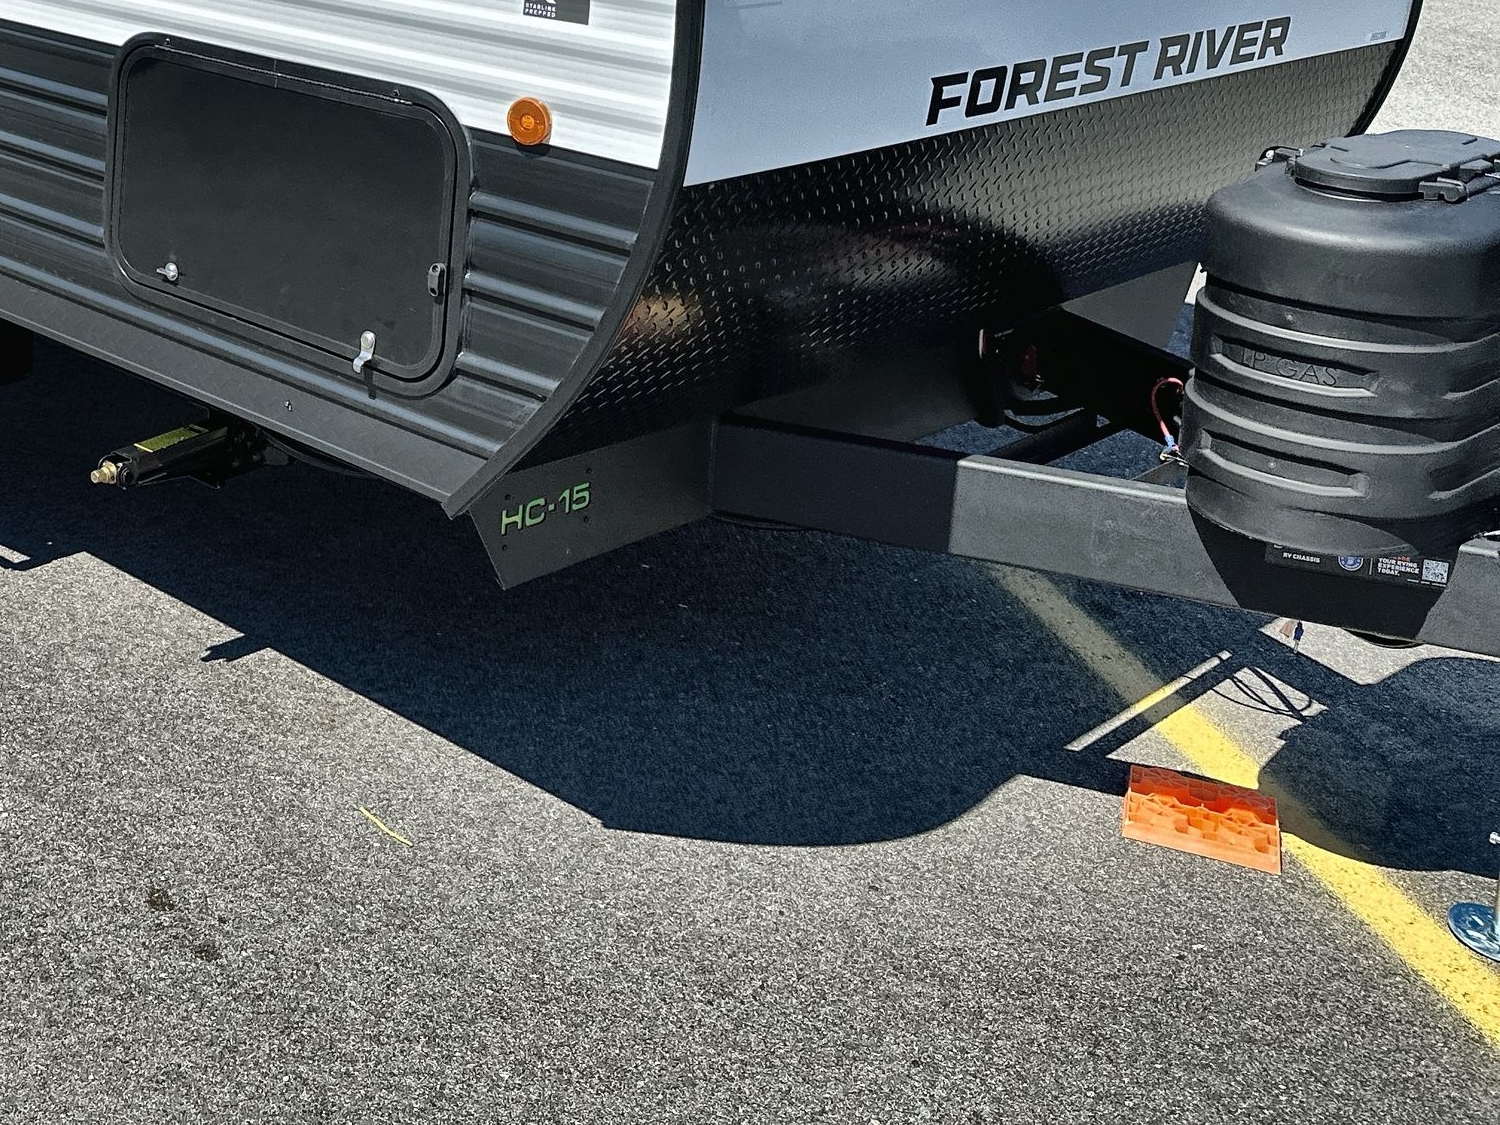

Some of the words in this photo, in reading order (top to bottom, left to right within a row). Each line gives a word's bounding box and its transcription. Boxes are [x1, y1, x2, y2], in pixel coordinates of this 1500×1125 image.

[525, 2, 556, 12] STARLINK
[524, 8, 556, 18] PREPPED
[926, 39, 1150, 127] FOREST
[1154, 16, 1292, 81] RIVER
[1275, 357, 1338, 386] GAS
[500, 482, 592, 536] HC-15
[1292, 553, 1321, 564] CHASSIS
[1378, 557, 1396, 565] YOUR
[1377, 562, 1420, 574] EXPERIENCE
